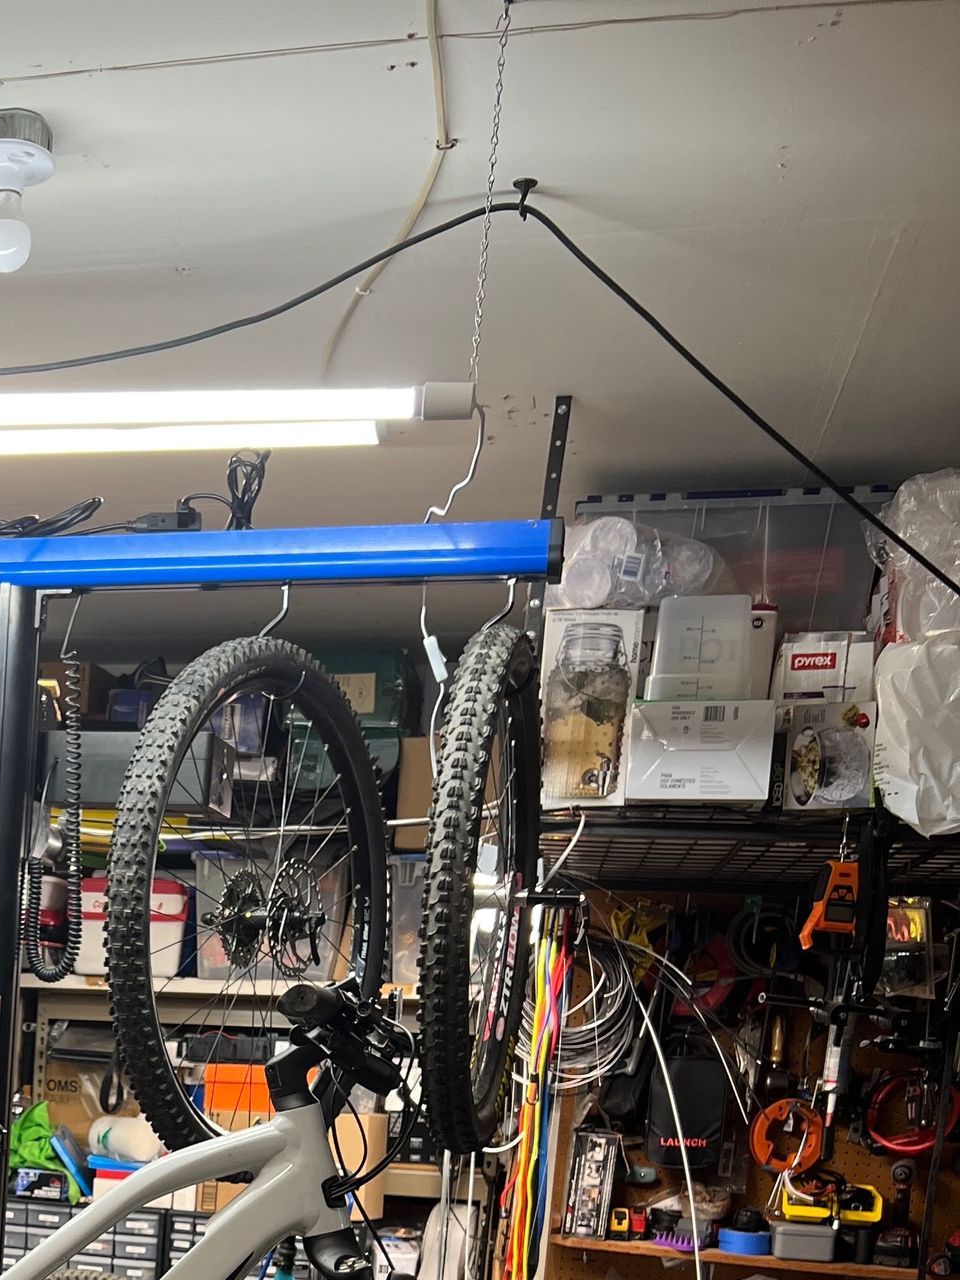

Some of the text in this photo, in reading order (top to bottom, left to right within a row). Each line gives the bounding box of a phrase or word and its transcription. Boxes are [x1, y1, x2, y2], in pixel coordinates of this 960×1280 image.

[628, 641, 640, 664] home
[793, 655, 833, 669] pyrex
[507, 908, 522, 967] FLOW
[500, 968, 515, 1017] ZTR
